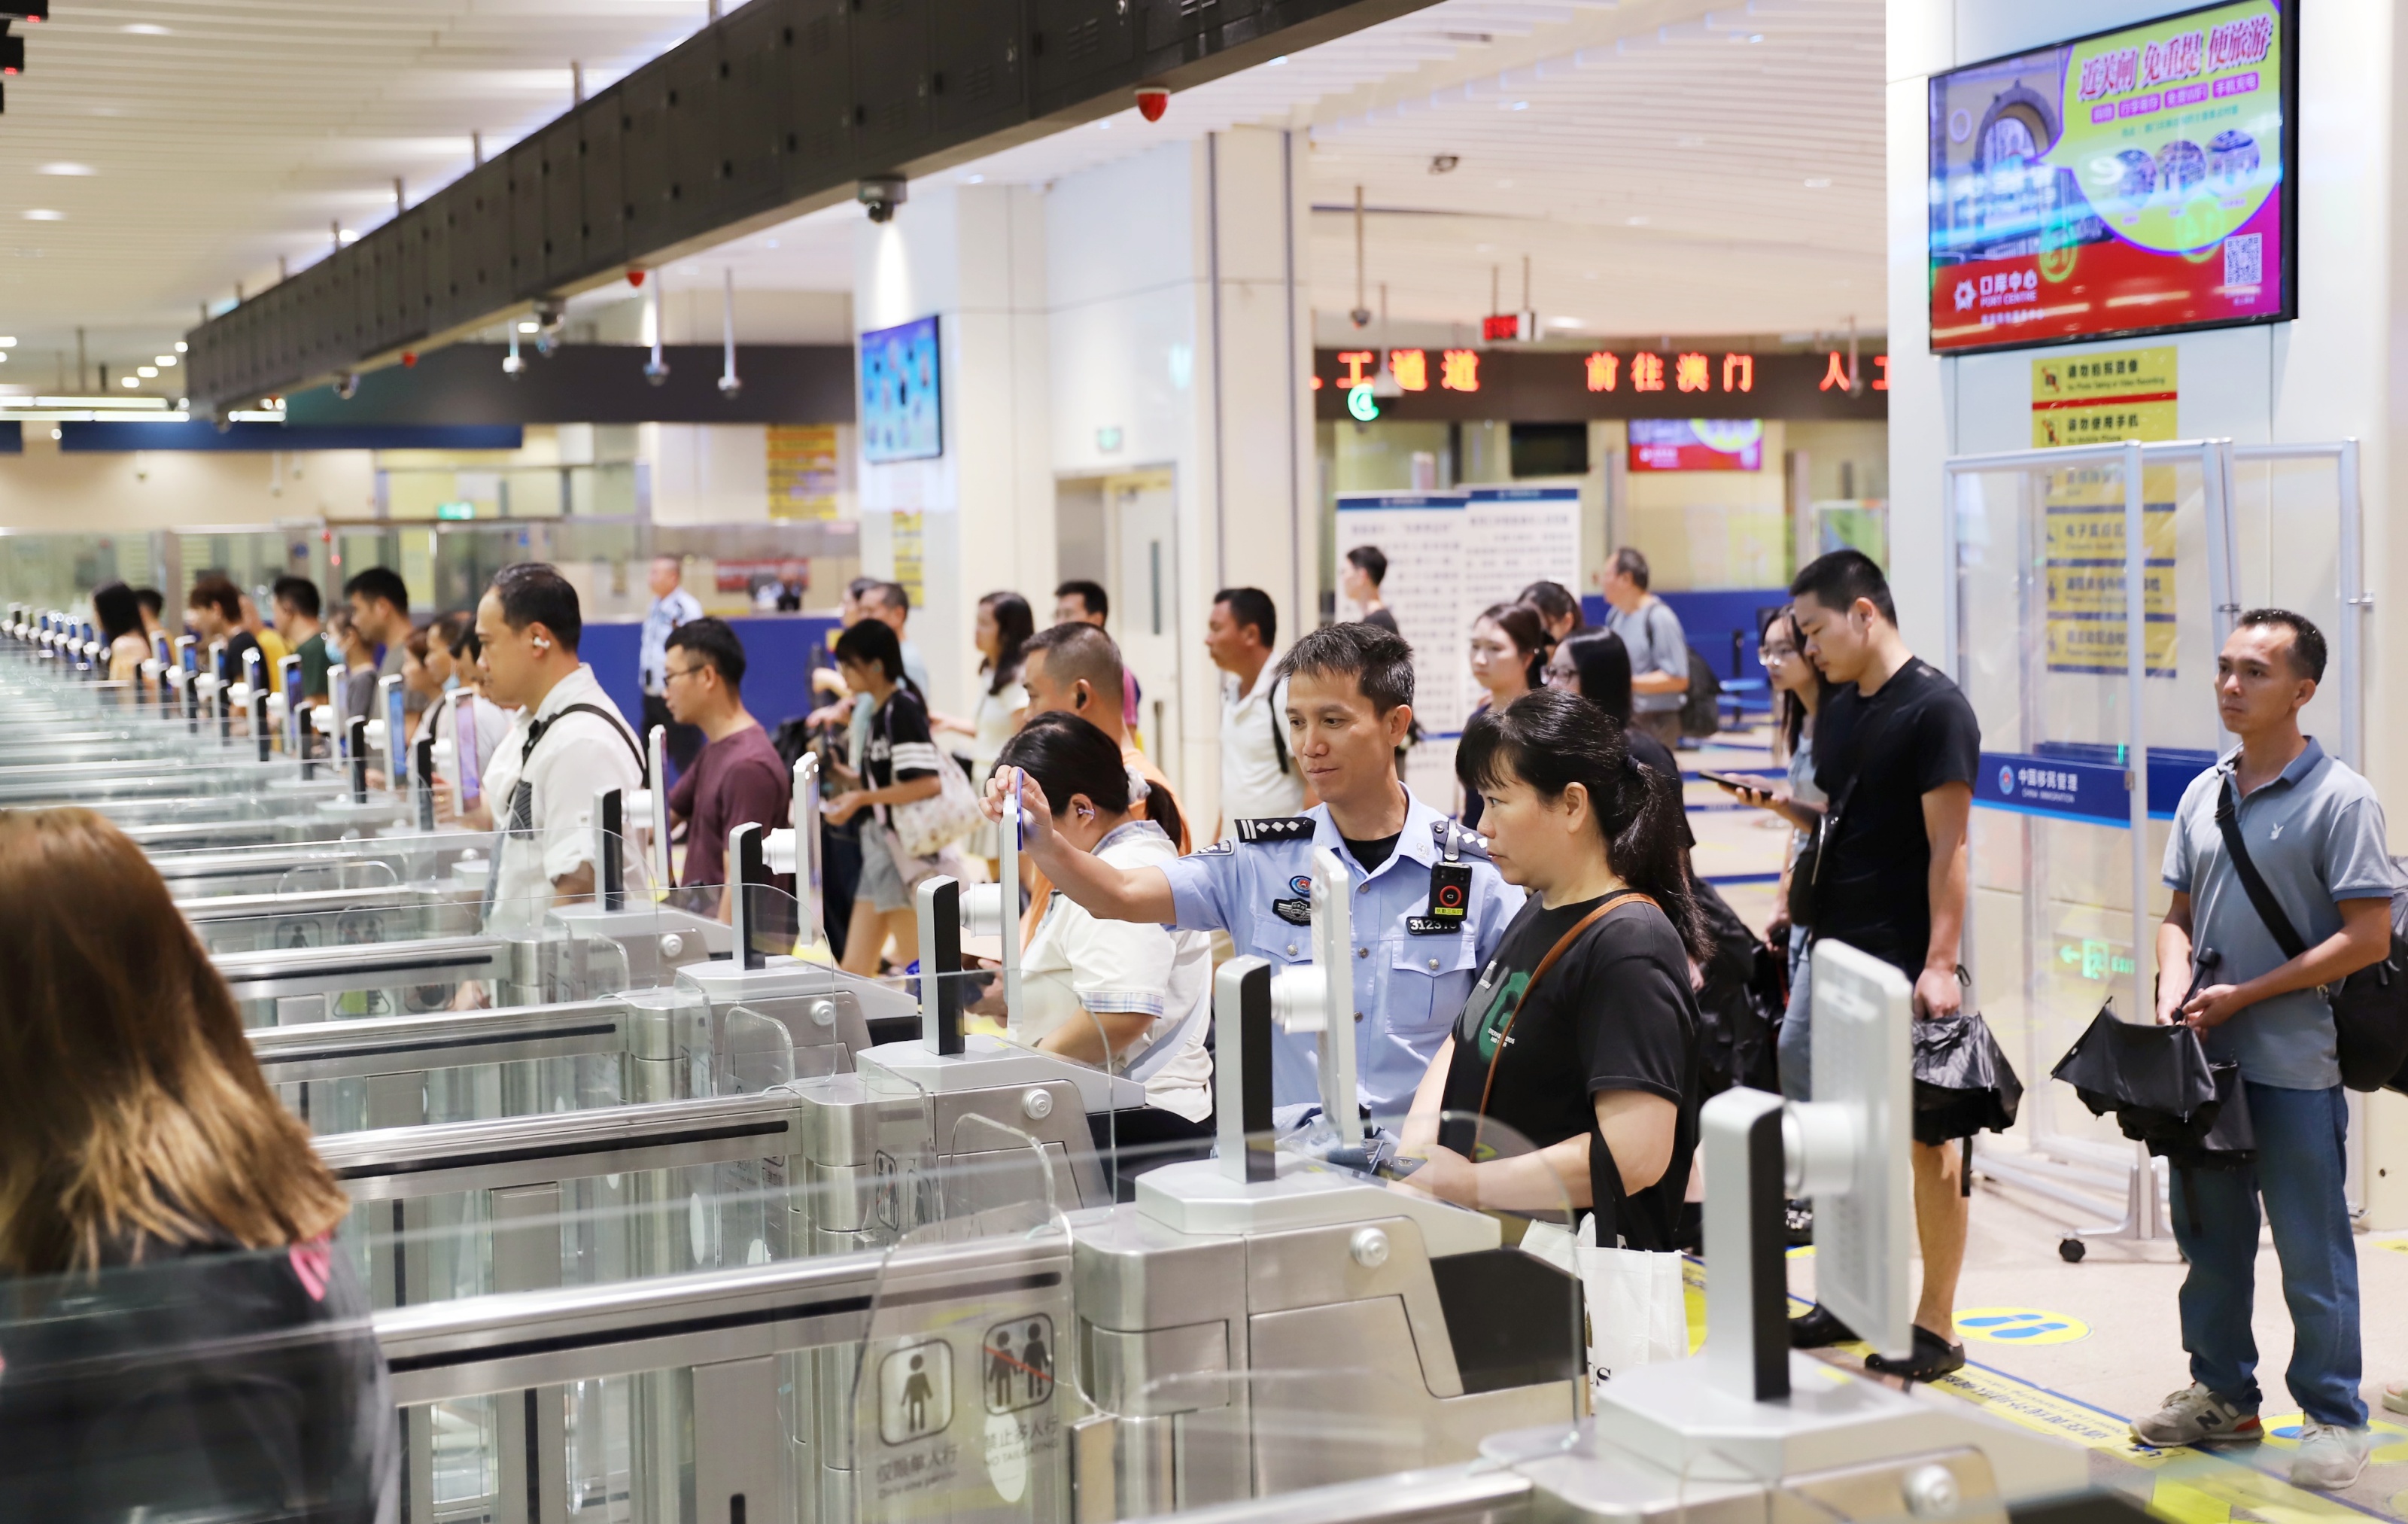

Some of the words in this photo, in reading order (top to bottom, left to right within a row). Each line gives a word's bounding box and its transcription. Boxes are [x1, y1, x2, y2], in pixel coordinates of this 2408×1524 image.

[2141, 31, 2201, 86] 免重提
[2207, 15, 2272, 71] 便旅游
[1980, 269, 2038, 296] 口岸中心
[1310, 349, 1479, 391] 工通道
[1585, 351, 1753, 392] 前往澳门
[2018, 767, 2078, 792] 中国移民管理
